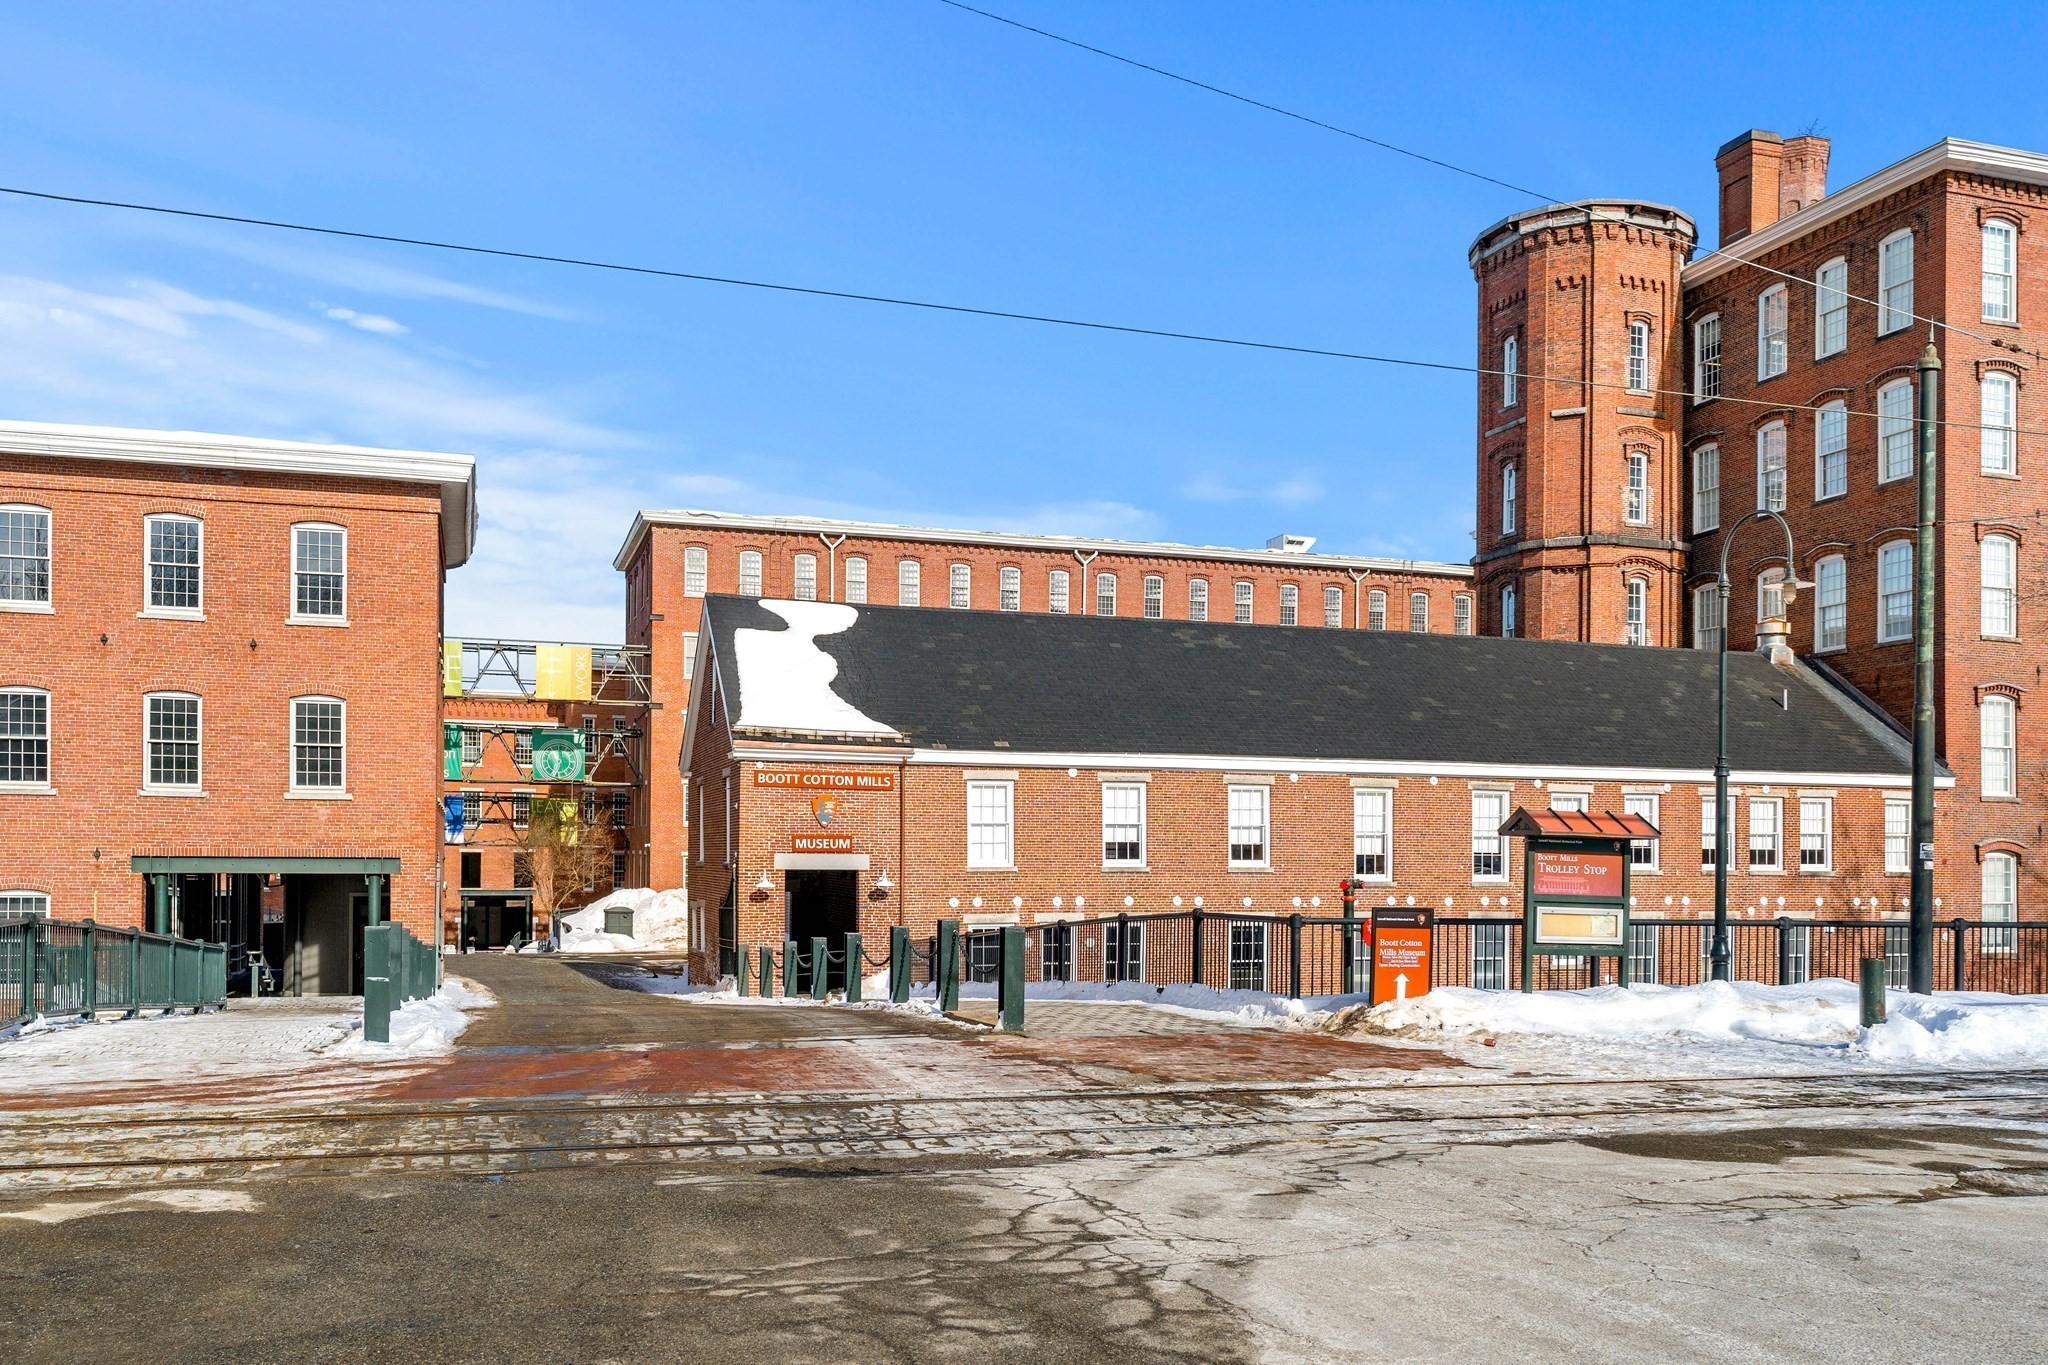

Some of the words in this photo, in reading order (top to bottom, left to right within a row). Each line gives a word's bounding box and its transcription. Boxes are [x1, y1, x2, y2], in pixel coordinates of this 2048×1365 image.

[576, 652, 588, 695] WORK
[758, 774, 800, 784] BOOTT
[804, 774, 854, 786] COTTON
[857, 776, 891, 787] MILLS
[796, 838, 850, 849] MUSEUM
[1538, 862, 1580, 874] TROLLEY
[1584, 864, 1607, 875] STOP
